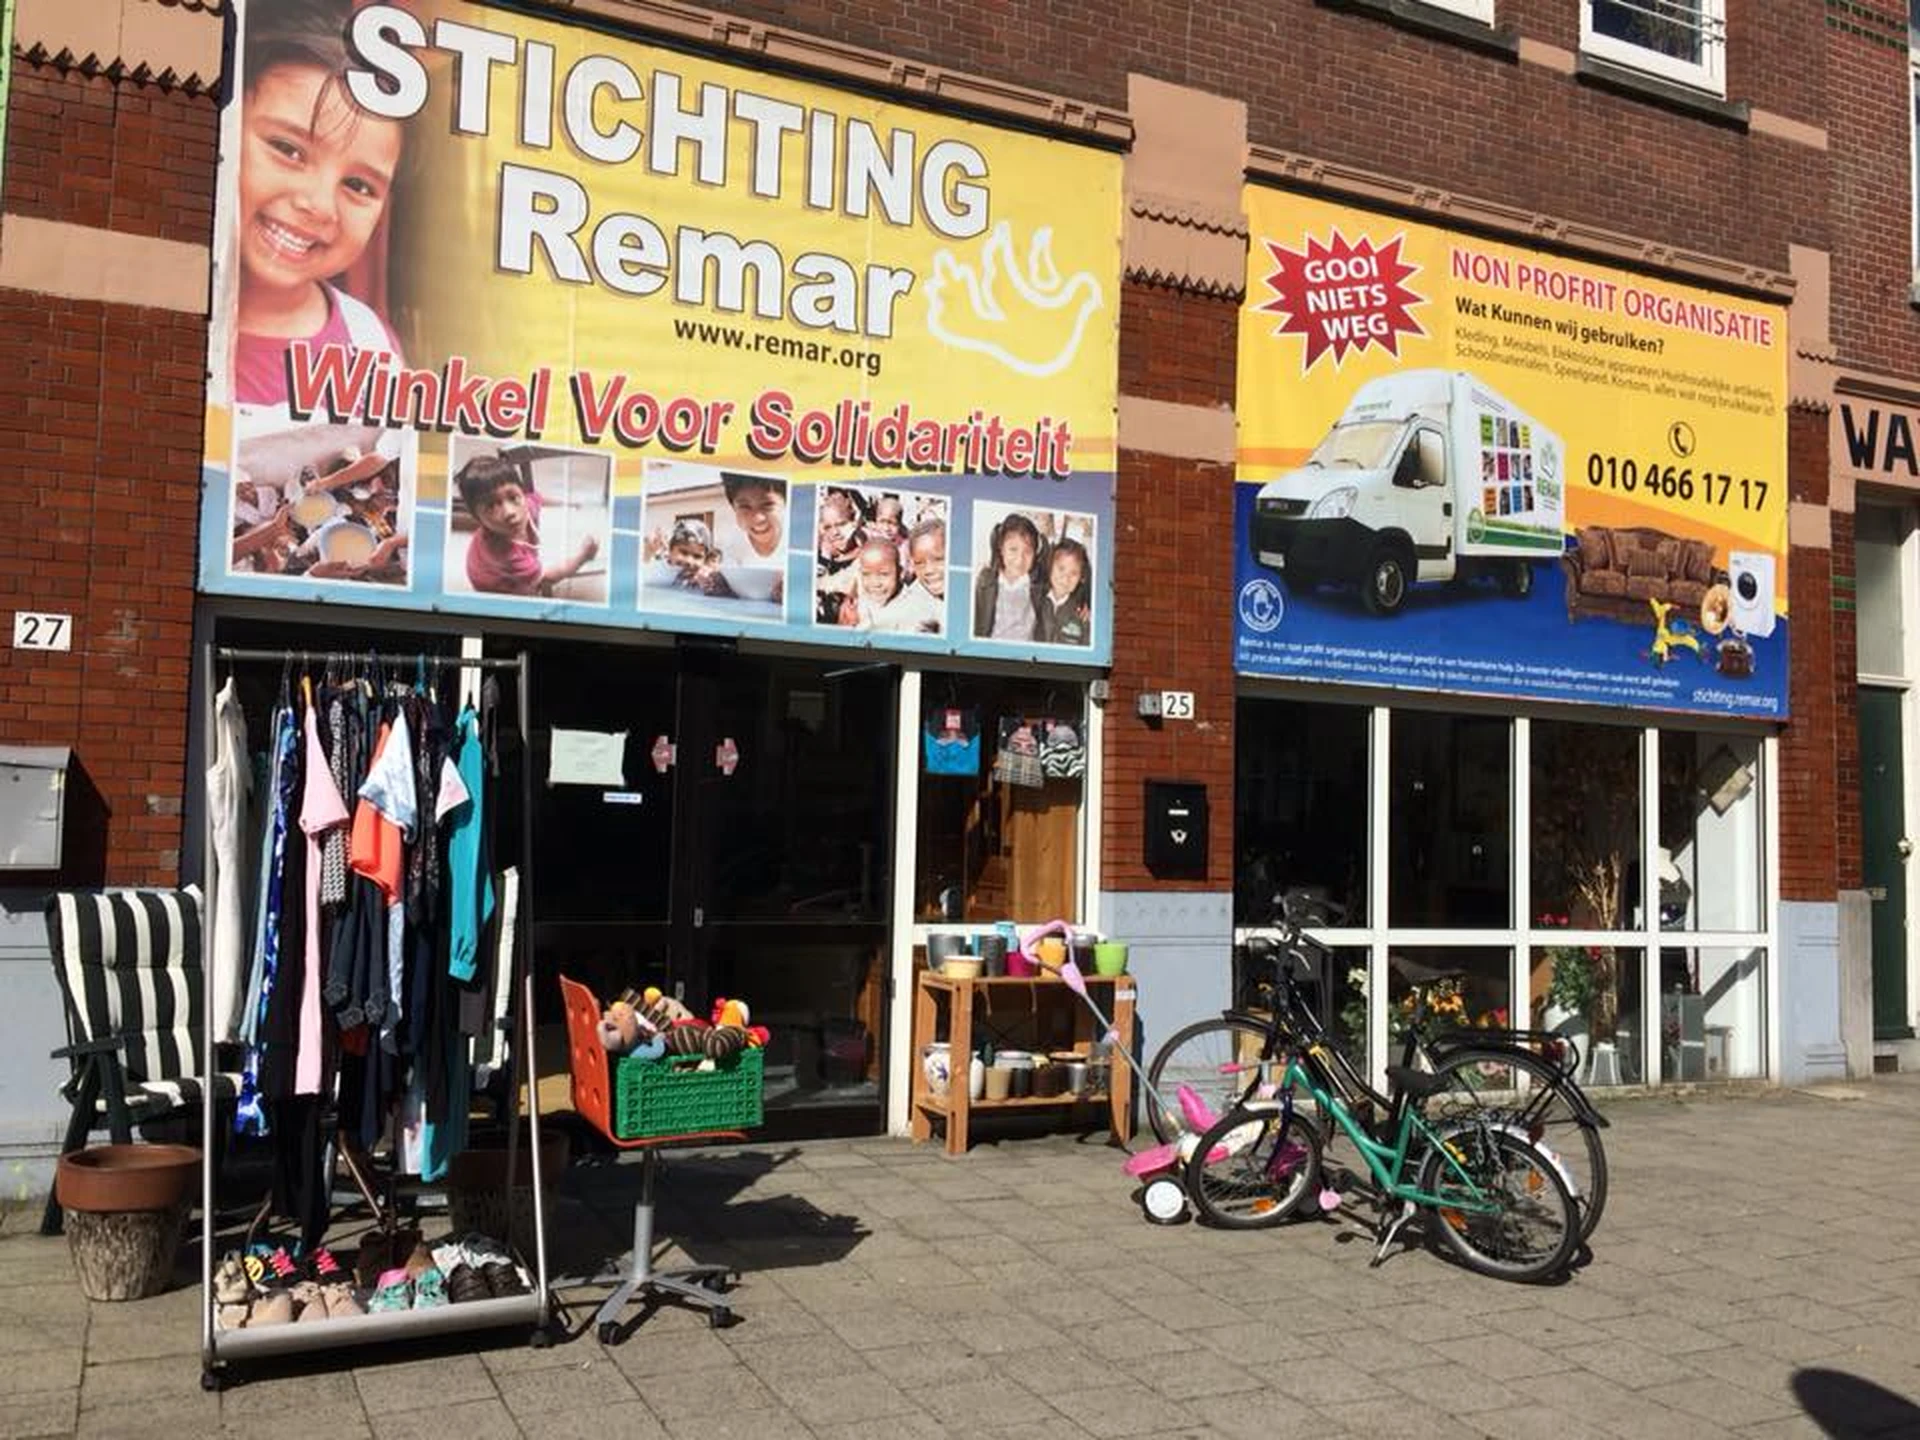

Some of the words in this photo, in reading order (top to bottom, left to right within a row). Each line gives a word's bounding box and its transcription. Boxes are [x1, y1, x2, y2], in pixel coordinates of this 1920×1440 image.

[344, 4, 989, 239] STICHTING
[498, 162, 915, 338] Remar
[1304, 256, 1379, 283] GOOI
[1306, 284, 1388, 313] NIETS
[1453, 250, 1509, 288] NON
[1517, 264, 1616, 310] PROFRIT
[1624, 289, 1771, 346] ORGANISATIE
[1456, 297, 1487, 318] Wat
[1491, 304, 1553, 331] Kunnen
[1556, 320, 1579, 340] wij
[674, 319, 881, 376] www.remar.org
[1322, 313, 1389, 341] WEG
[286, 341, 551, 439] Winkel
[569, 370, 733, 453] Voor
[746, 389, 1071, 478] Solidariteit
[1840, 403, 1920, 476] WA
[1588, 453, 1637, 492] 010
[1644, 464, 1694, 500] 466
[1703, 472, 1731, 506] 17
[1740, 479, 1768, 511] 17
[22, 616, 65, 645] 27
[1166, 694, 1190, 717] 25
